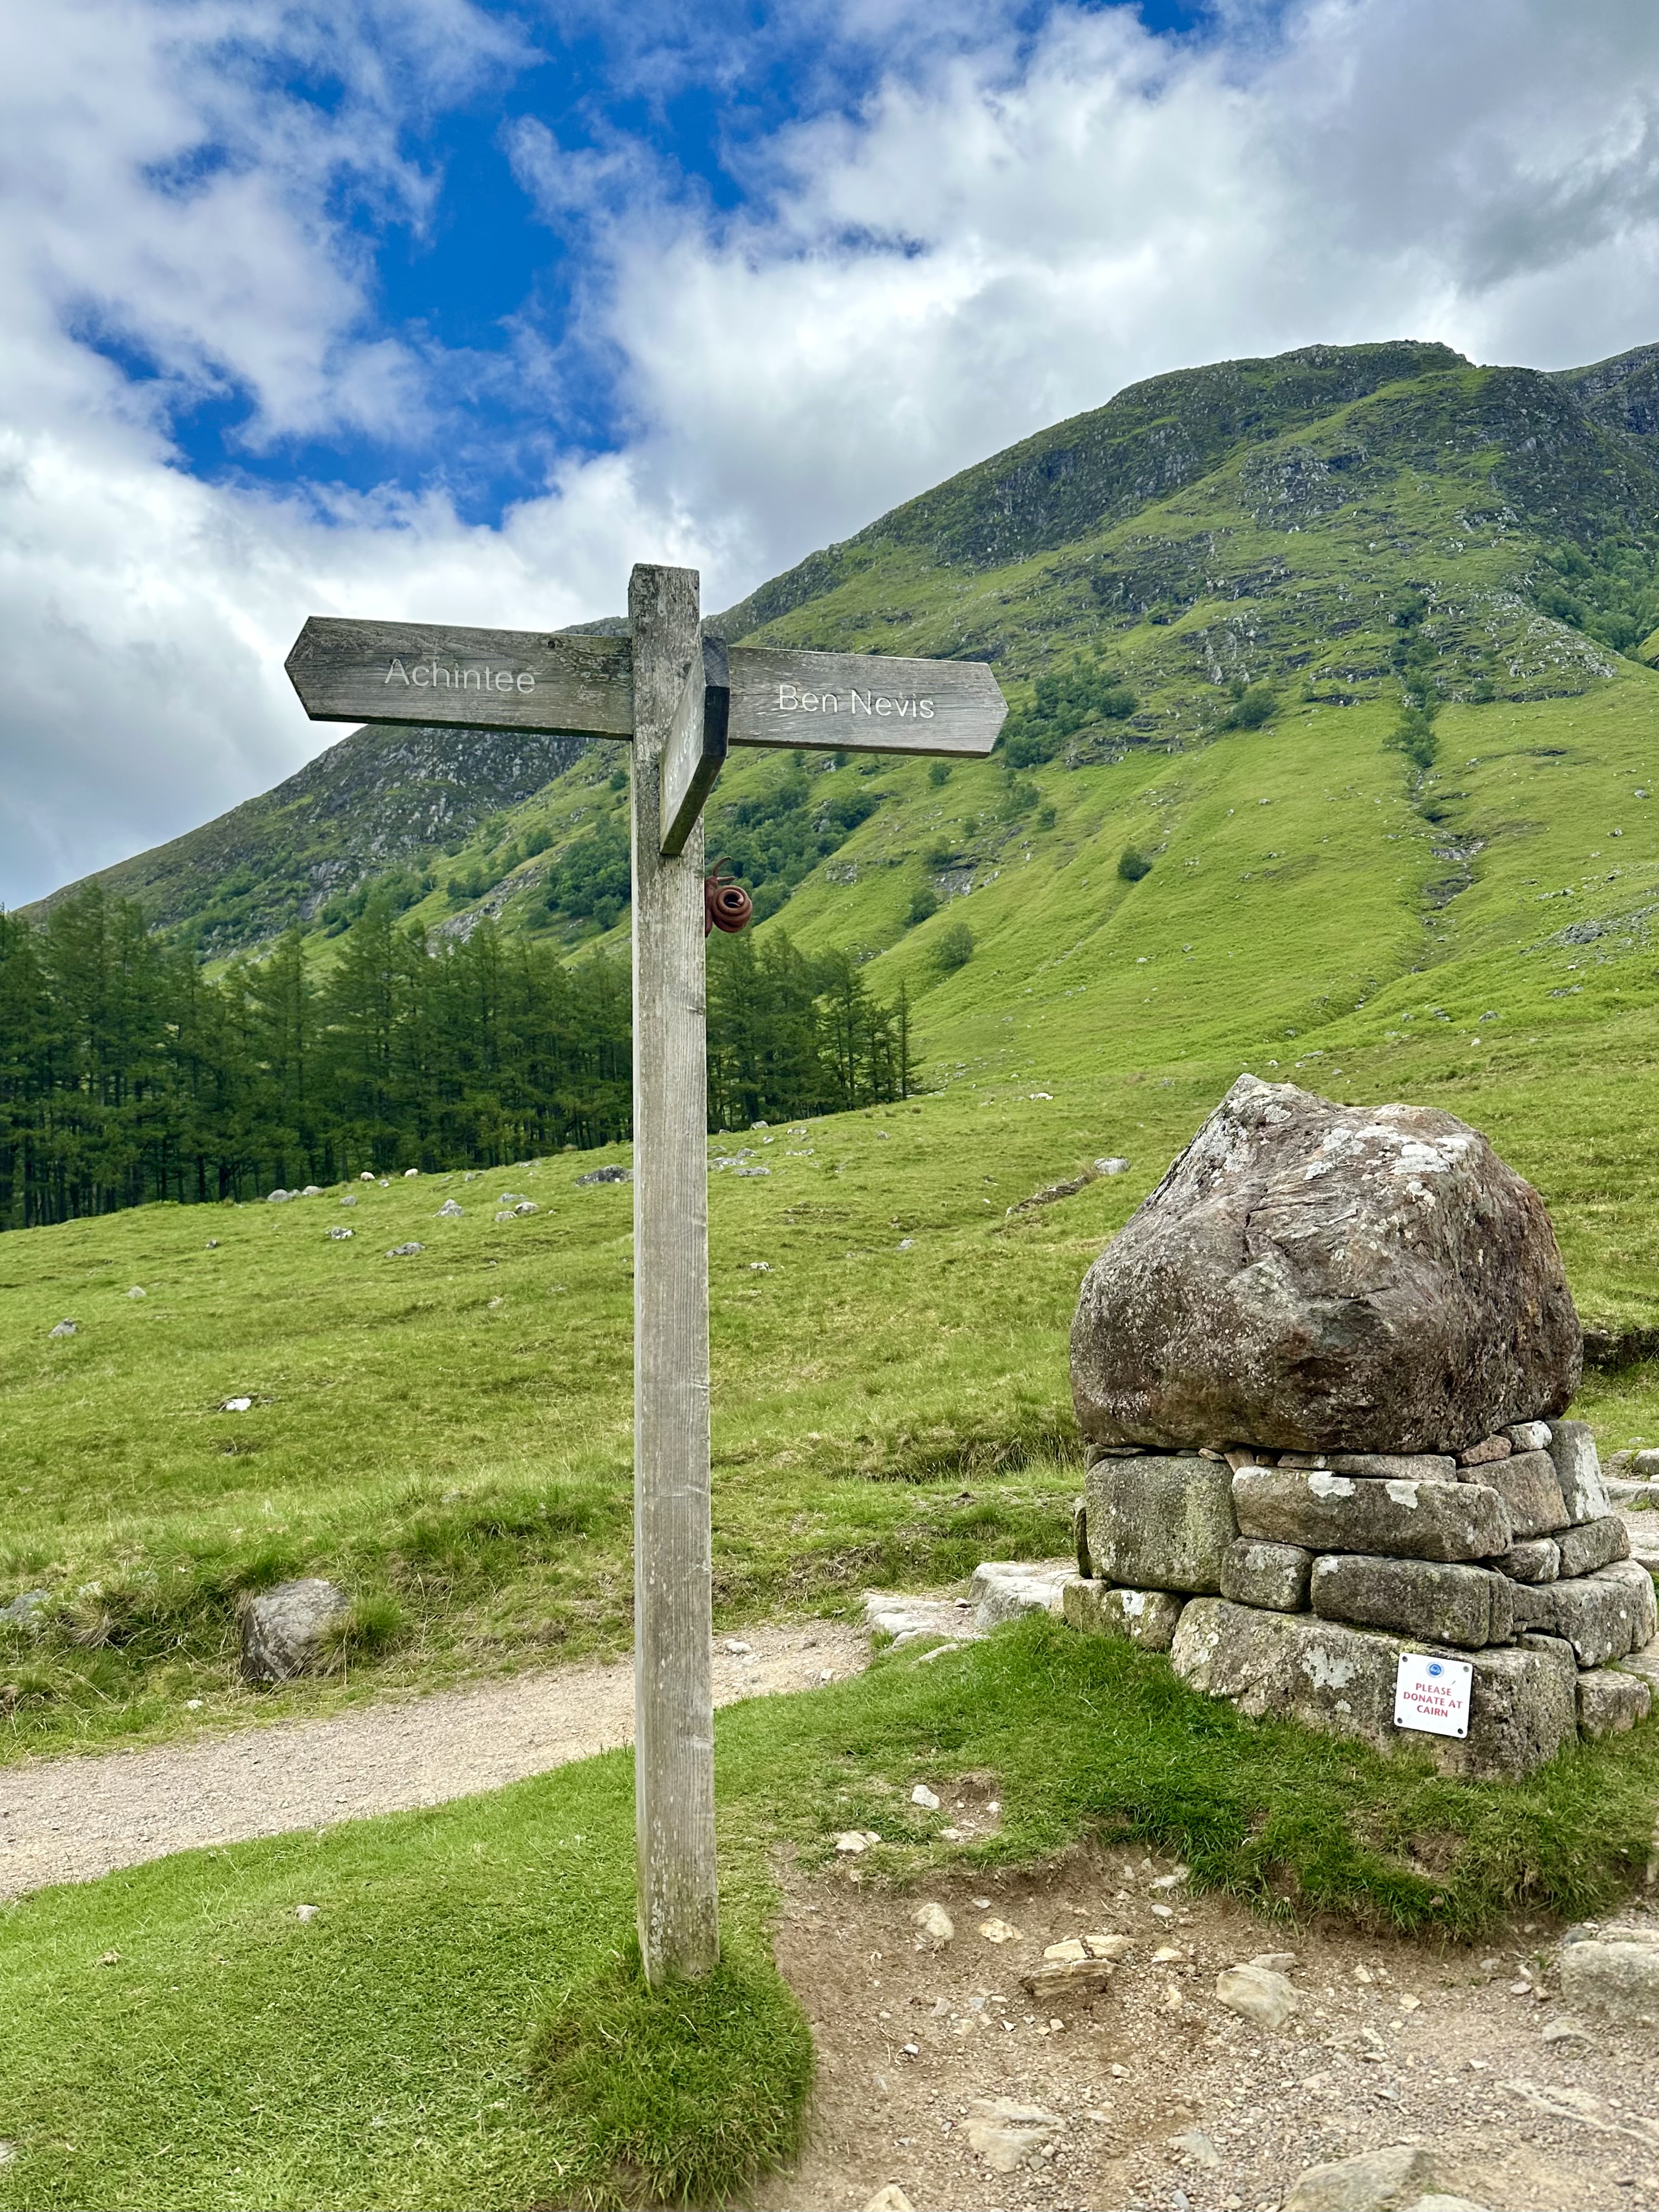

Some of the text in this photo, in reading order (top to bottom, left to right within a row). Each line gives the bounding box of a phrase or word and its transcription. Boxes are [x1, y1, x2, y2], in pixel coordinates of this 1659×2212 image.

[384, 658, 536, 694] Achintee
[779, 684, 934, 718] Ben Nevis
[1416, 1683, 1451, 1696] PLEASE
[1404, 1692, 1463, 1708] DONATE AT
[1417, 1705, 1449, 1717] CAIRN
